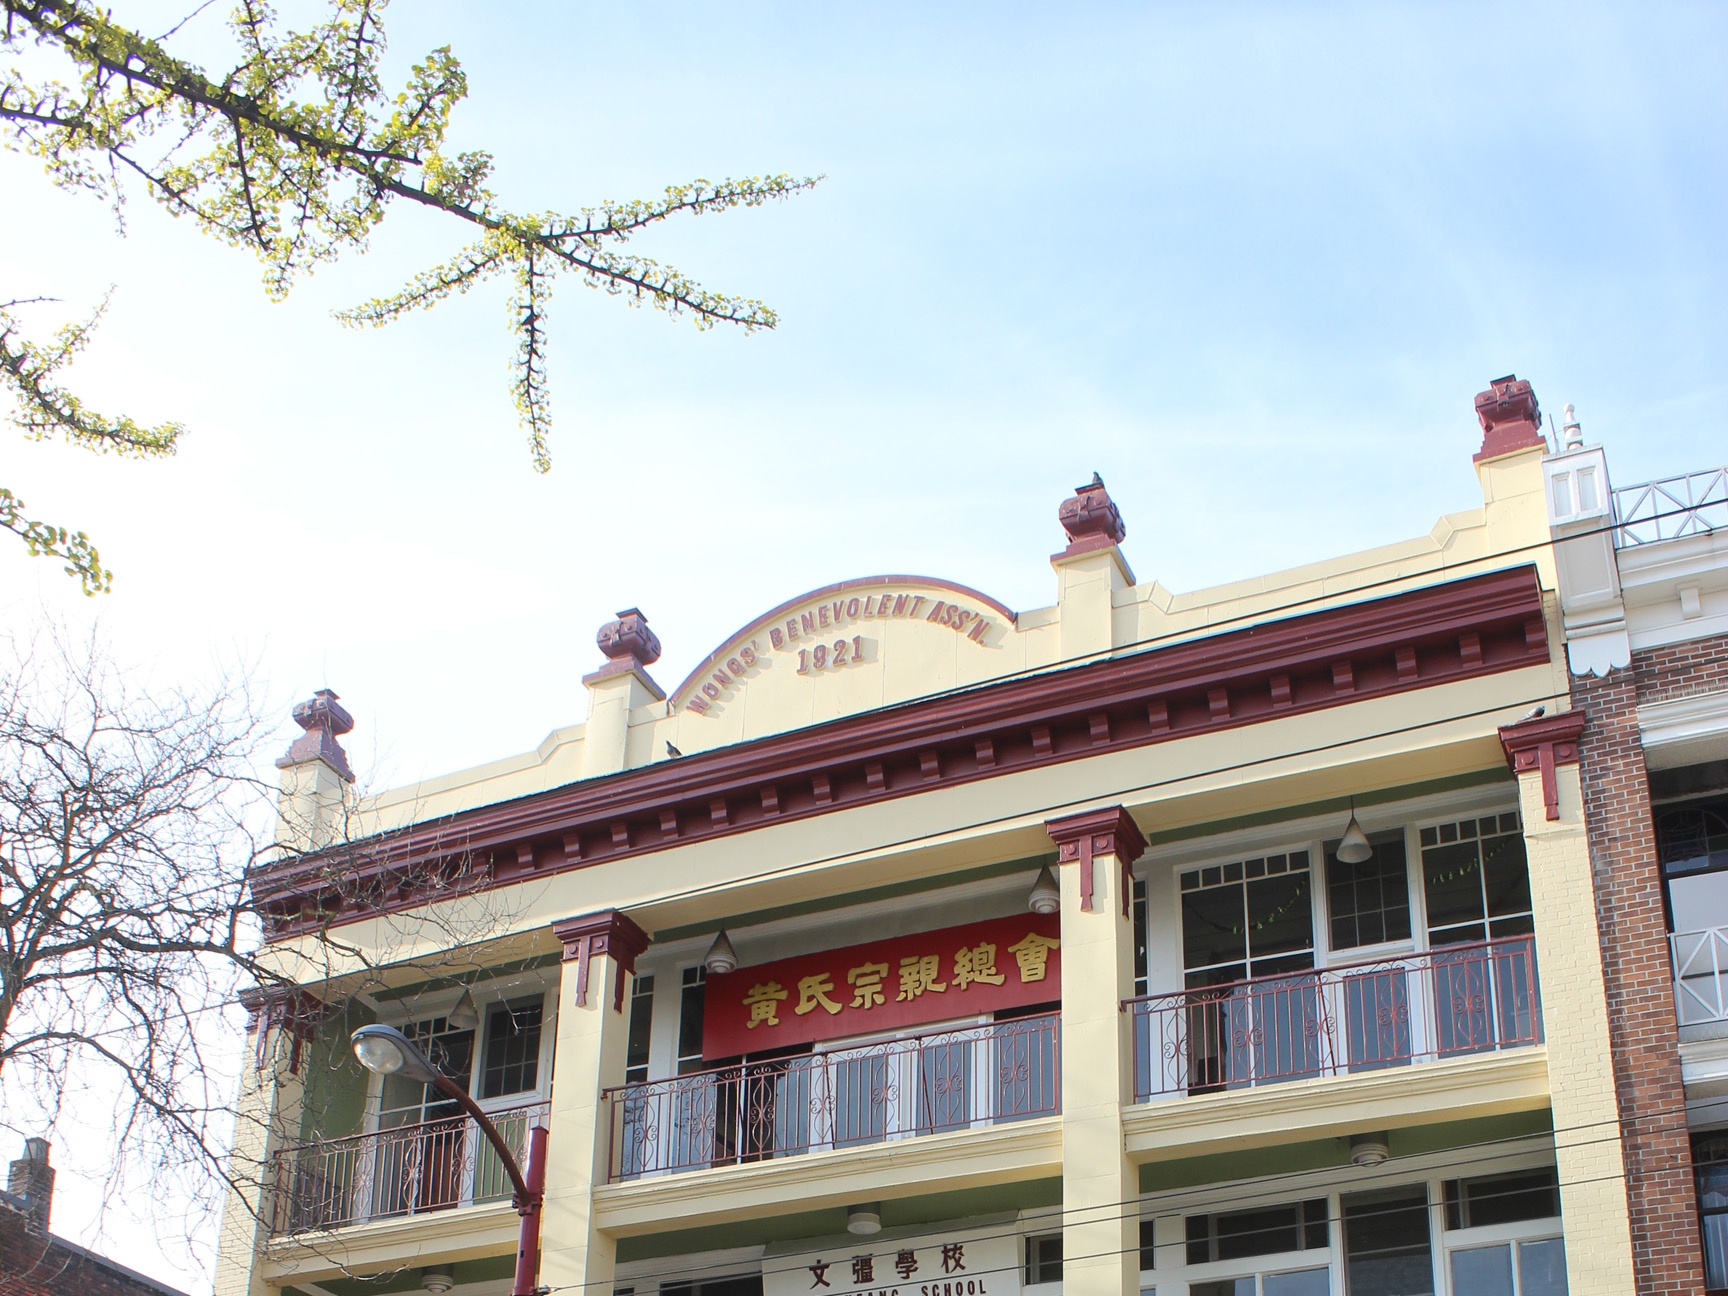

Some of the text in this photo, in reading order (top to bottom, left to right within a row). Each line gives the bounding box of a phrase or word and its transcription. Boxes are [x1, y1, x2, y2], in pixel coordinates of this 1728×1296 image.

[769, 593, 925, 651] BENEVOLENT
[797, 635, 864, 675] 1921
[742, 932, 1060, 1030] 黃氏宗親總會
